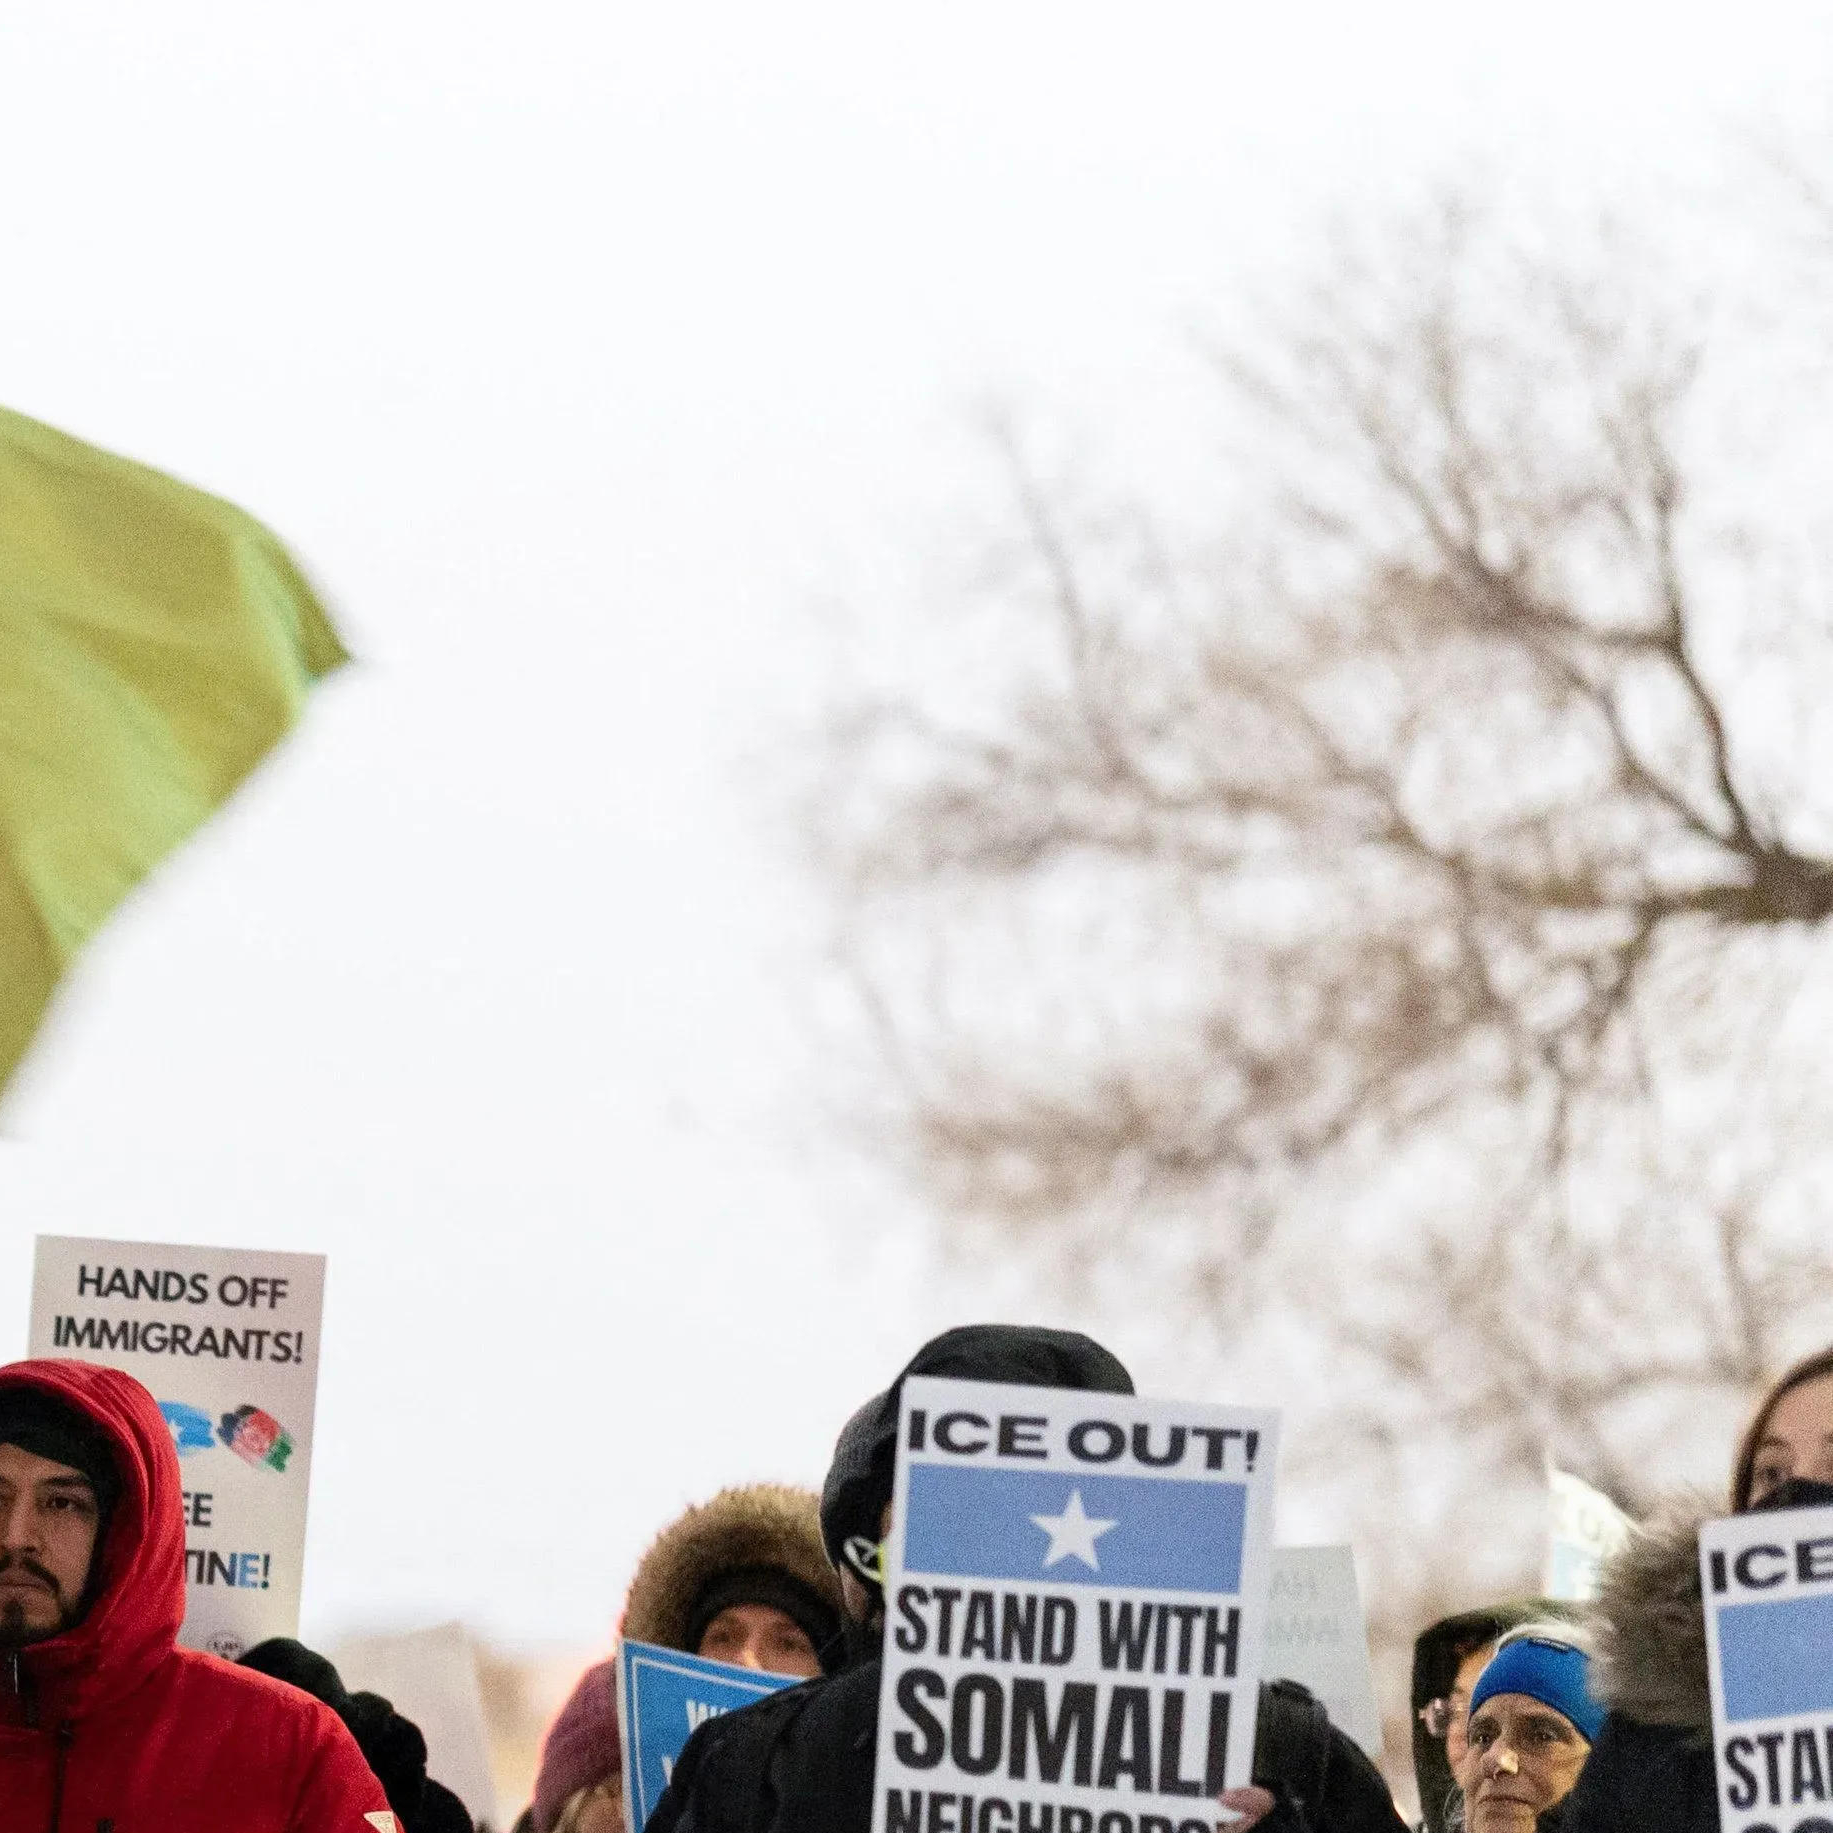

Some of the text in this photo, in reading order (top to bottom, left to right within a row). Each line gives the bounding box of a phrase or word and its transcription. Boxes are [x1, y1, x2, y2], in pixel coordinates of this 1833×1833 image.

[77, 1264, 289, 1309] HANDS OFF
[53, 1316, 303, 1364] IMMIGRANTS!
[908, 1408, 1259, 1473] ICE OUT!
[896, 1584, 1242, 1678] STAND WITH
[894, 1667, 1234, 1799] SOMALI
[1725, 1725, 1833, 1812] STA
